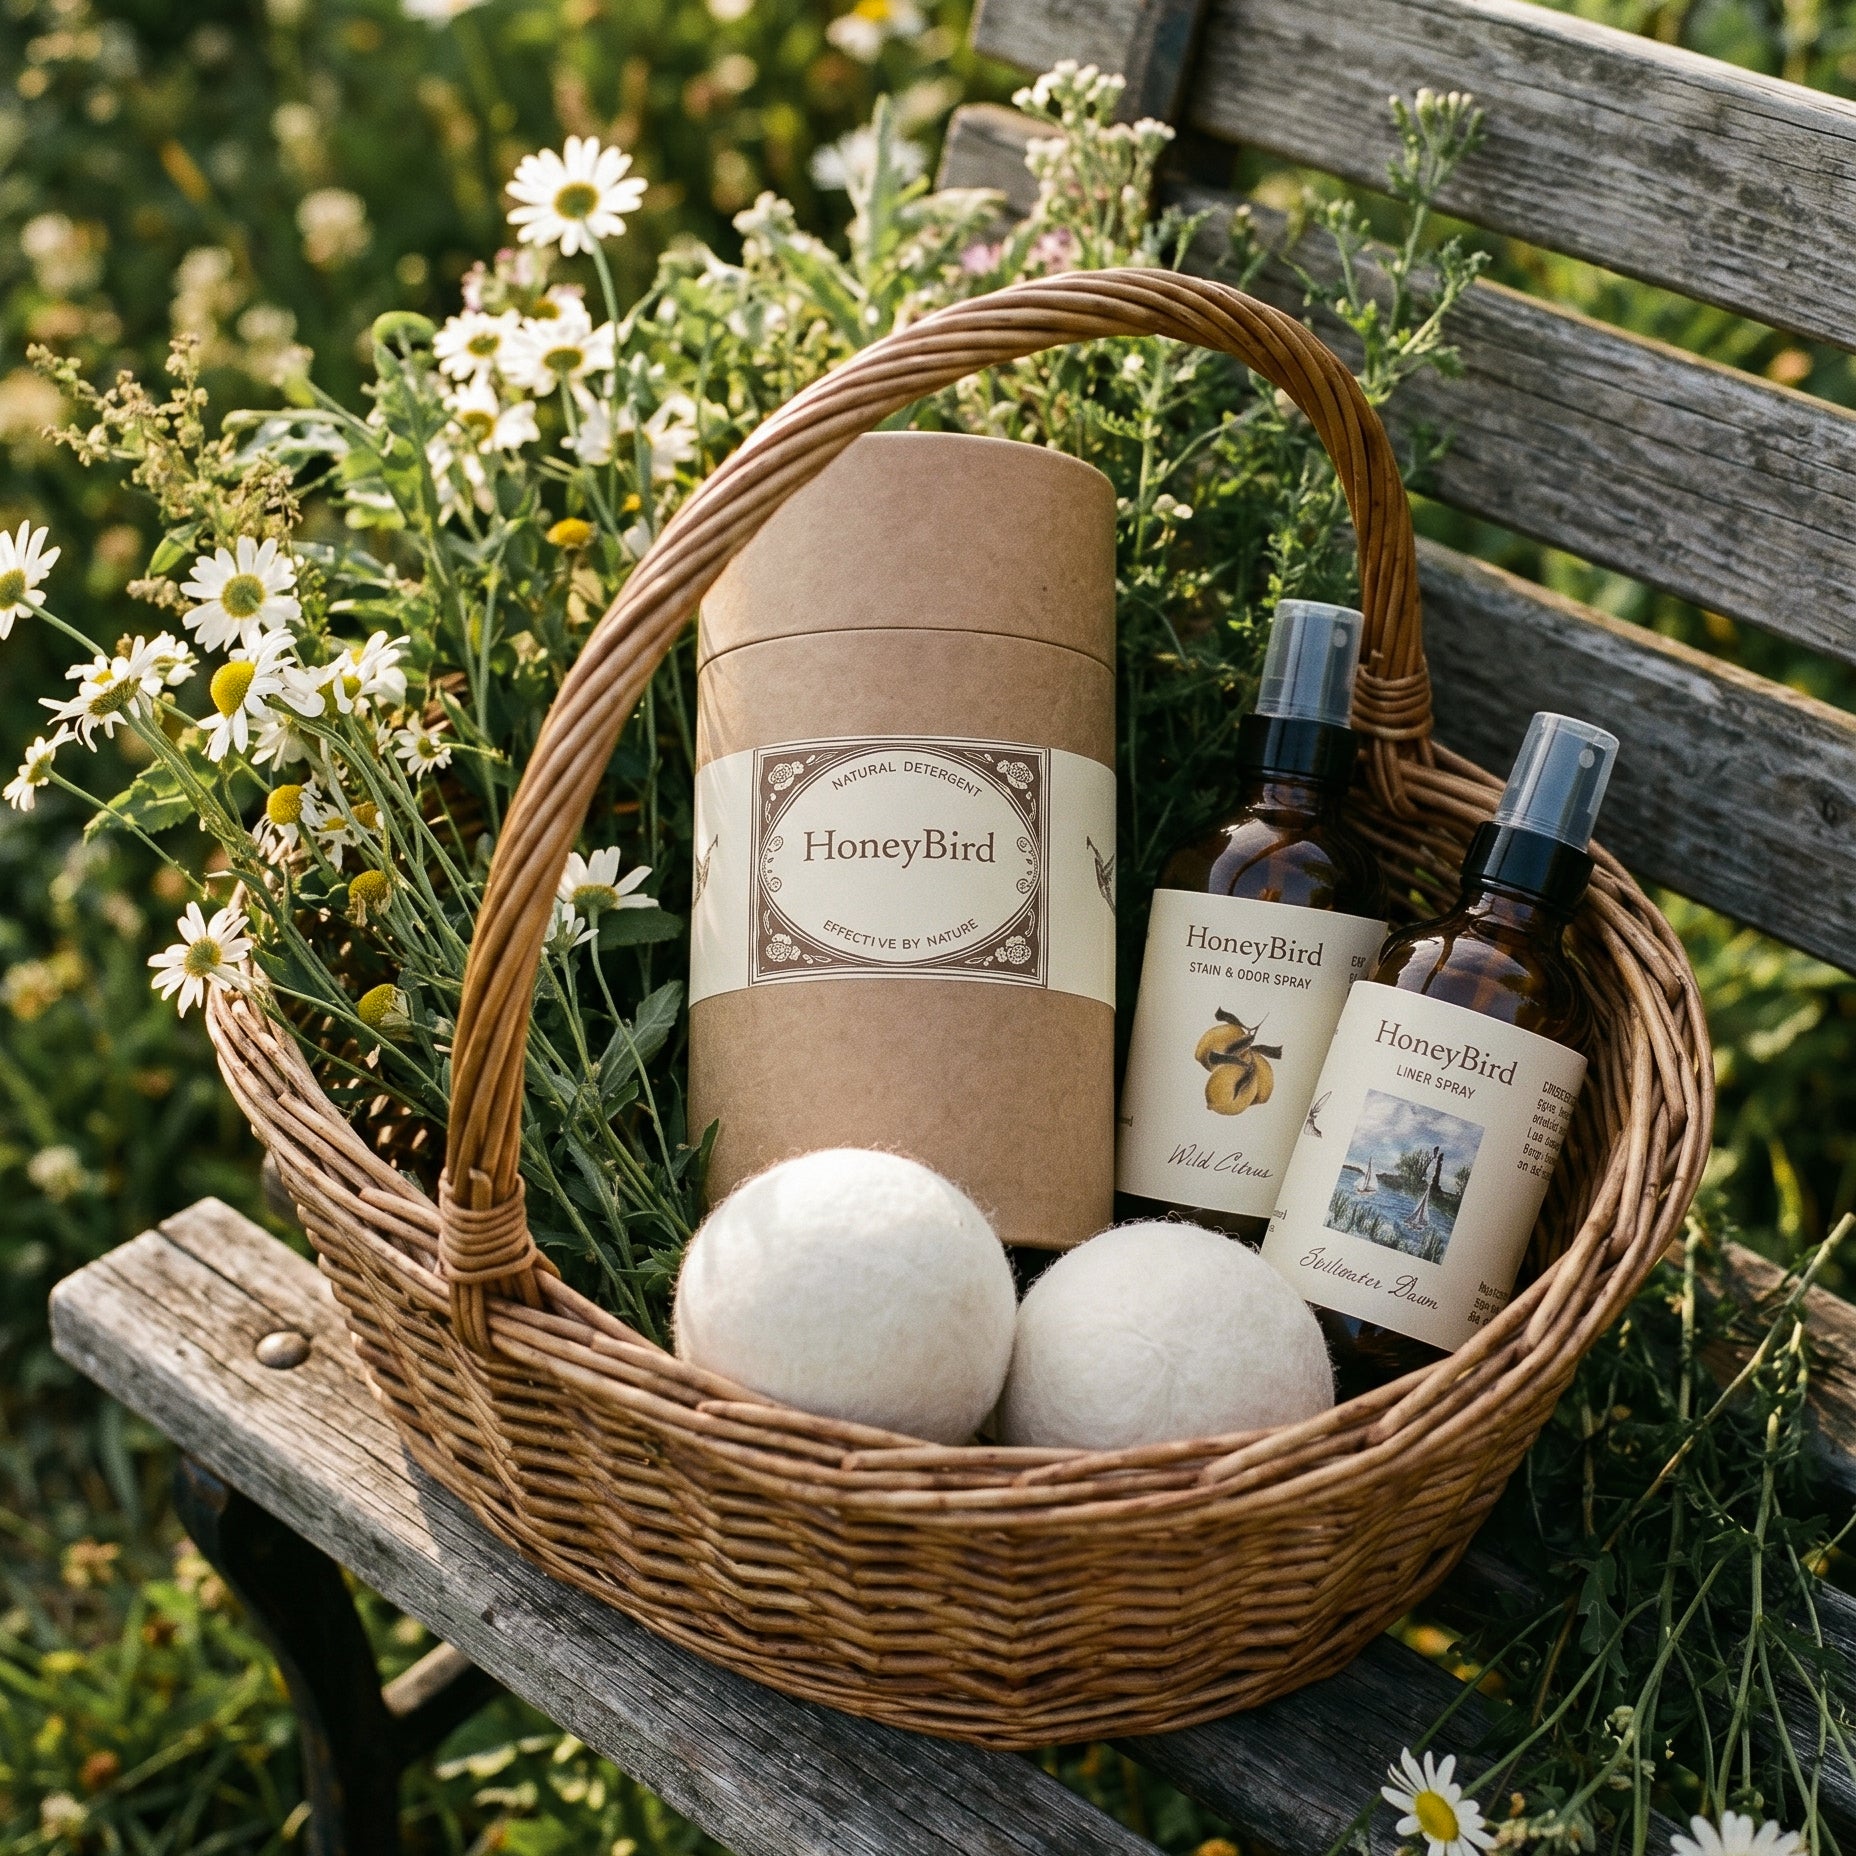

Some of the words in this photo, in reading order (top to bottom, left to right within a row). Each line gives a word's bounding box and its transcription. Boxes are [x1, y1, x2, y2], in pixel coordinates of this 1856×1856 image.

[832, 761, 896, 791] NATURAL
[904, 761, 983, 798] DETERGENT
[803, 828, 996, 869] HoneyBird
[823, 920, 897, 949] EFFECTIVE
[902, 936, 921, 950] BY
[927, 918, 979, 947] NATURE
[1186, 925, 1324, 967] HoneyBird
[1189, 962, 1221, 977] STAIN
[1225, 967, 1234, 978] &
[1237, 968, 1270, 984] ODOR
[1274, 974, 1312, 990] SPRAY
[1375, 1019, 1518, 1086] HoneyBird
[1396, 1064, 1432, 1086] LINER
[1435, 1076, 1476, 1100] SPRAY
[1168, 1143, 1210, 1169] Wild
[1213, 1152, 1273, 1179] Citrus
